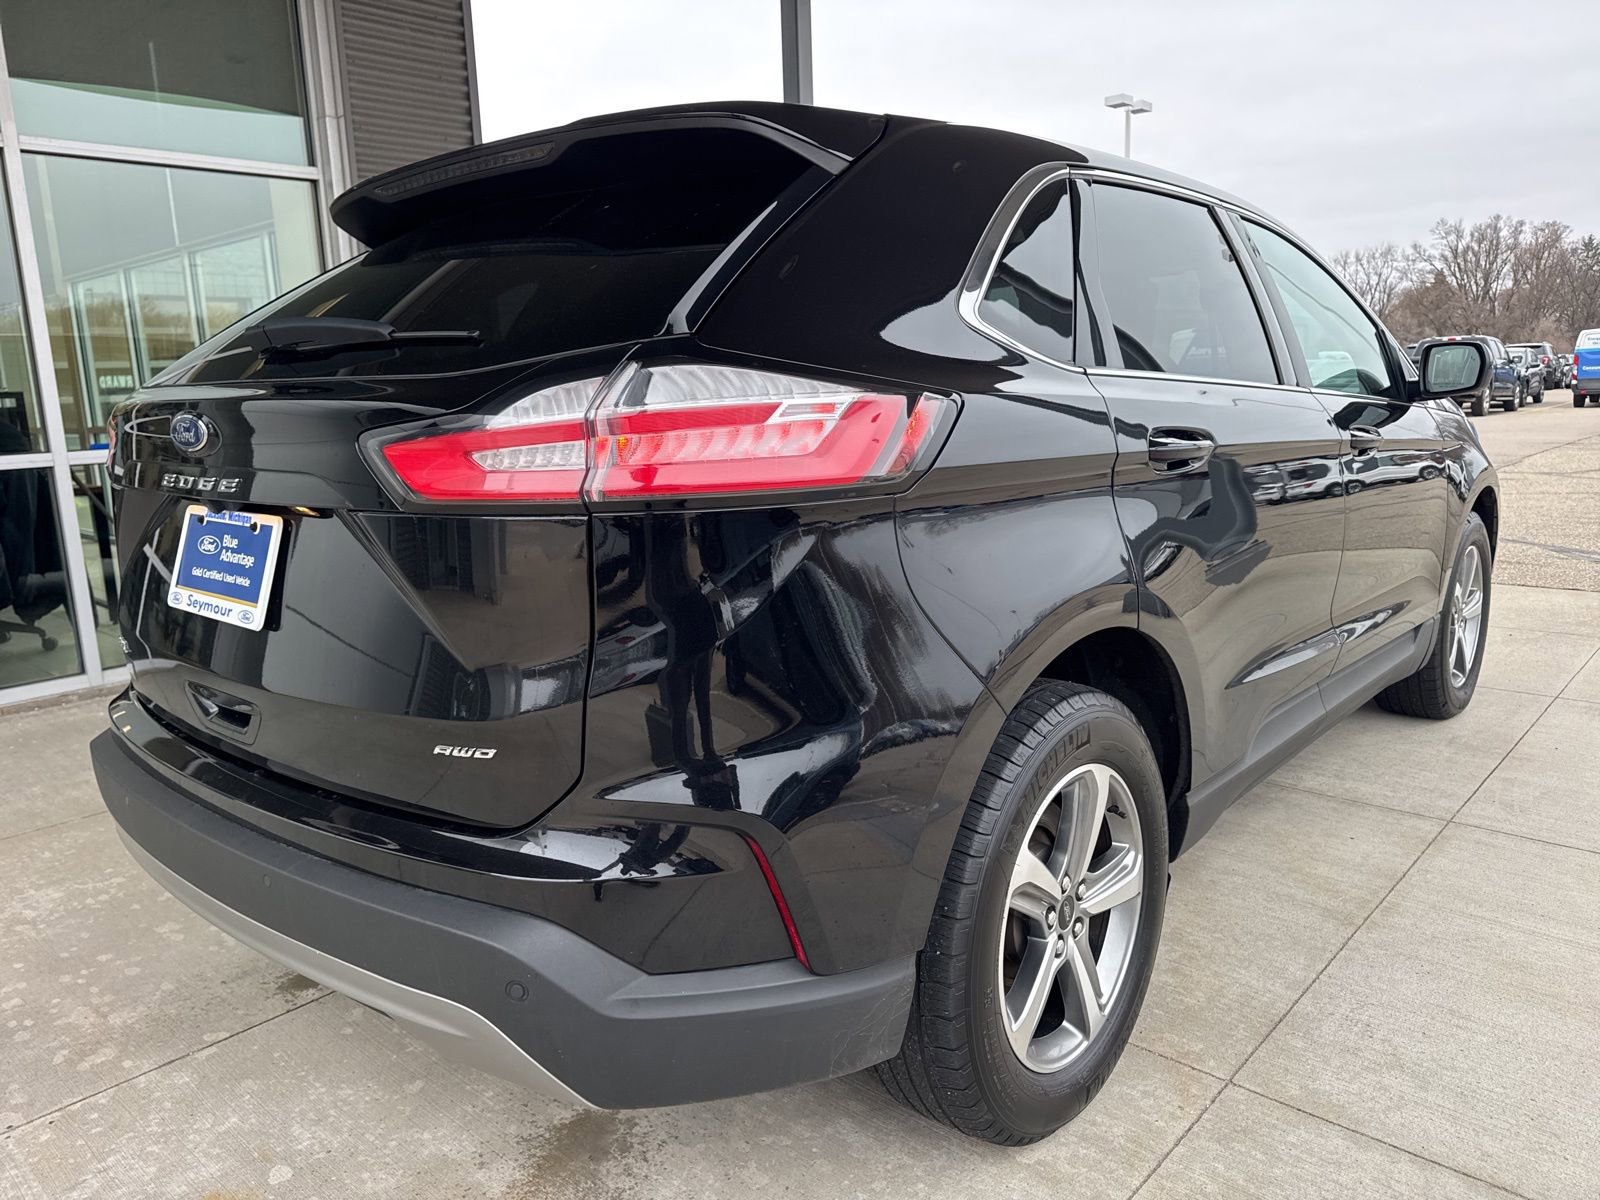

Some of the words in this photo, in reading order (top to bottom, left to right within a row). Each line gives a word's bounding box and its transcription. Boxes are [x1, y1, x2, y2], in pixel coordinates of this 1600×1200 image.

[175, 421, 196, 443] Ford
[161, 473, 239, 492] EDGE
[201, 537, 217, 552] Ford
[223, 534, 239, 549] Blue
[220, 549, 255, 568] Advantage
[192, 566, 203, 576] Gold
[202, 568, 223, 581] Certified
[223, 573, 236, 584] Used
[235, 576, 251, 588] Vehicle
[187, 594, 232, 617] Seymour
[433, 745, 497, 758] AWD
